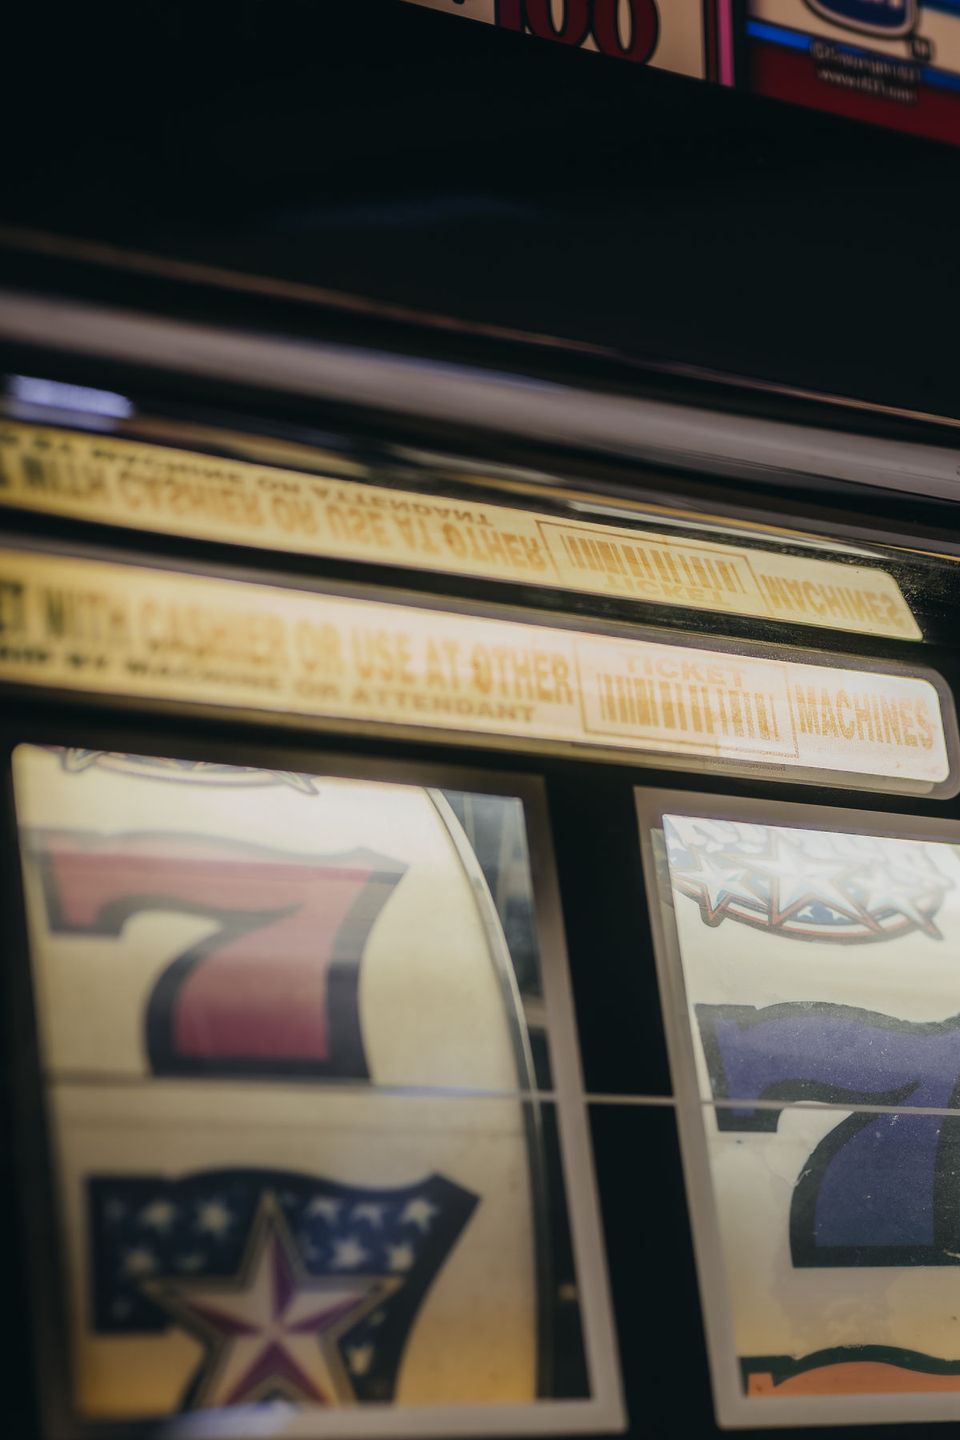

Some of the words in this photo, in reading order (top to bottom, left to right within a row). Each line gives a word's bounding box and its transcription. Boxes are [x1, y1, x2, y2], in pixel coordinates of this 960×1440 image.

[469, 642, 575, 705] OTHER
[622, 652, 746, 688] TICKET
[792, 682, 935, 751] MACHINES
